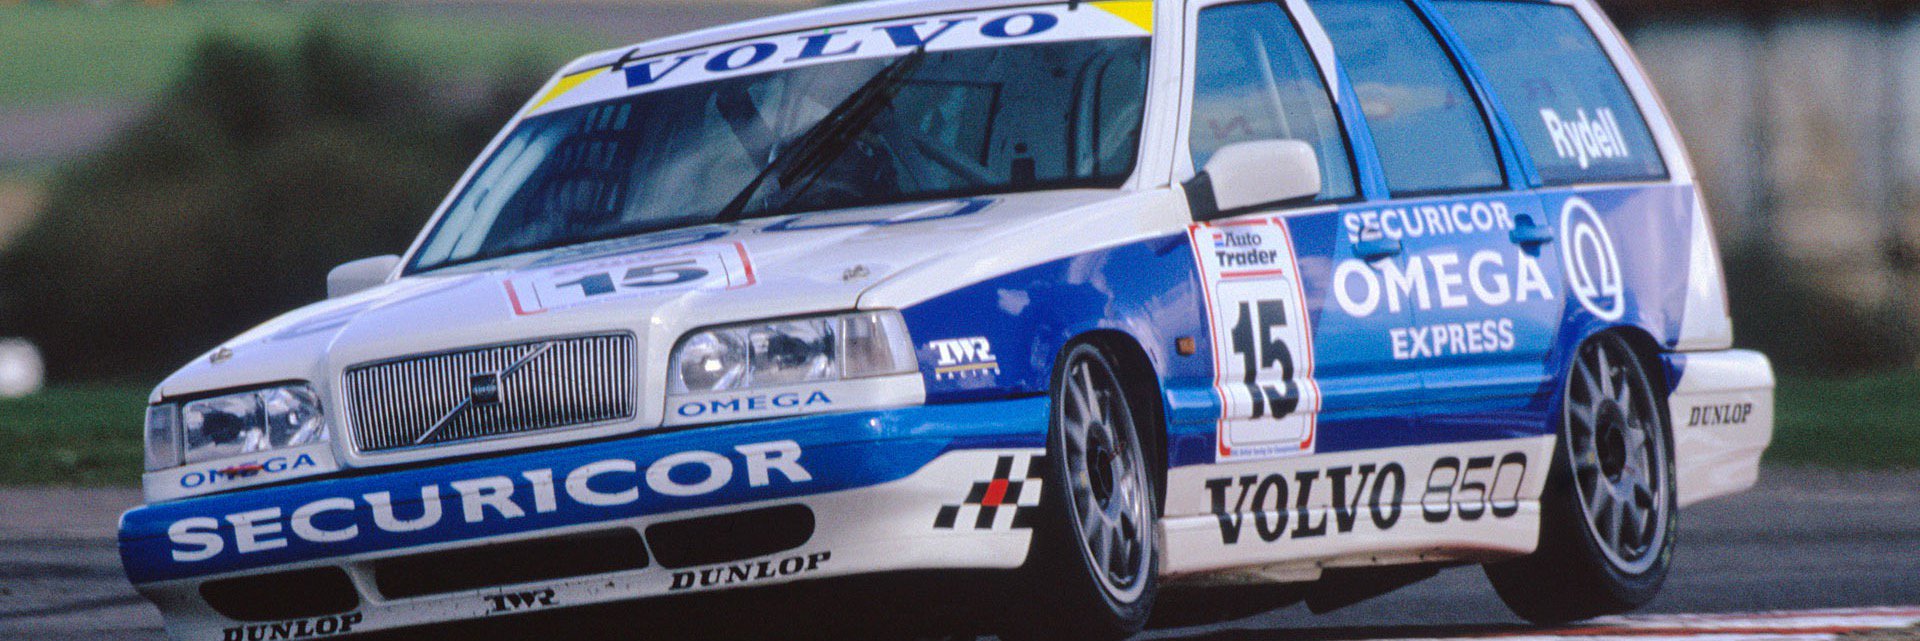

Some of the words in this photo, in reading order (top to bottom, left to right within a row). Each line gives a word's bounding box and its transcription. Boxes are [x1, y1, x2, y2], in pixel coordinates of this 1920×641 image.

[622, 12, 1058, 89] VOLVO
[1540, 108, 1628, 168] Rydell
[1225, 232, 1262, 247] Auto
[1344, 200, 1516, 244] SECURICOR
[1216, 249, 1277, 267] Trader
[555, 259, 709, 297] 15
[1333, 249, 1553, 317] OMEGA
[929, 336, 996, 366] TWR
[1392, 319, 1515, 359] EXPRESS
[1231, 299, 1300, 420] 15
[678, 391, 832, 417] OMEGA
[1688, 403, 1752, 427] DUNLOP
[168, 439, 812, 562] SECURICOR
[1205, 461, 1406, 544] VOLVO
[1422, 452, 1528, 523] 850
[669, 551, 831, 590] DUNLOP
[484, 588, 560, 613] TWR
[222, 612, 363, 641] DUNLOP
